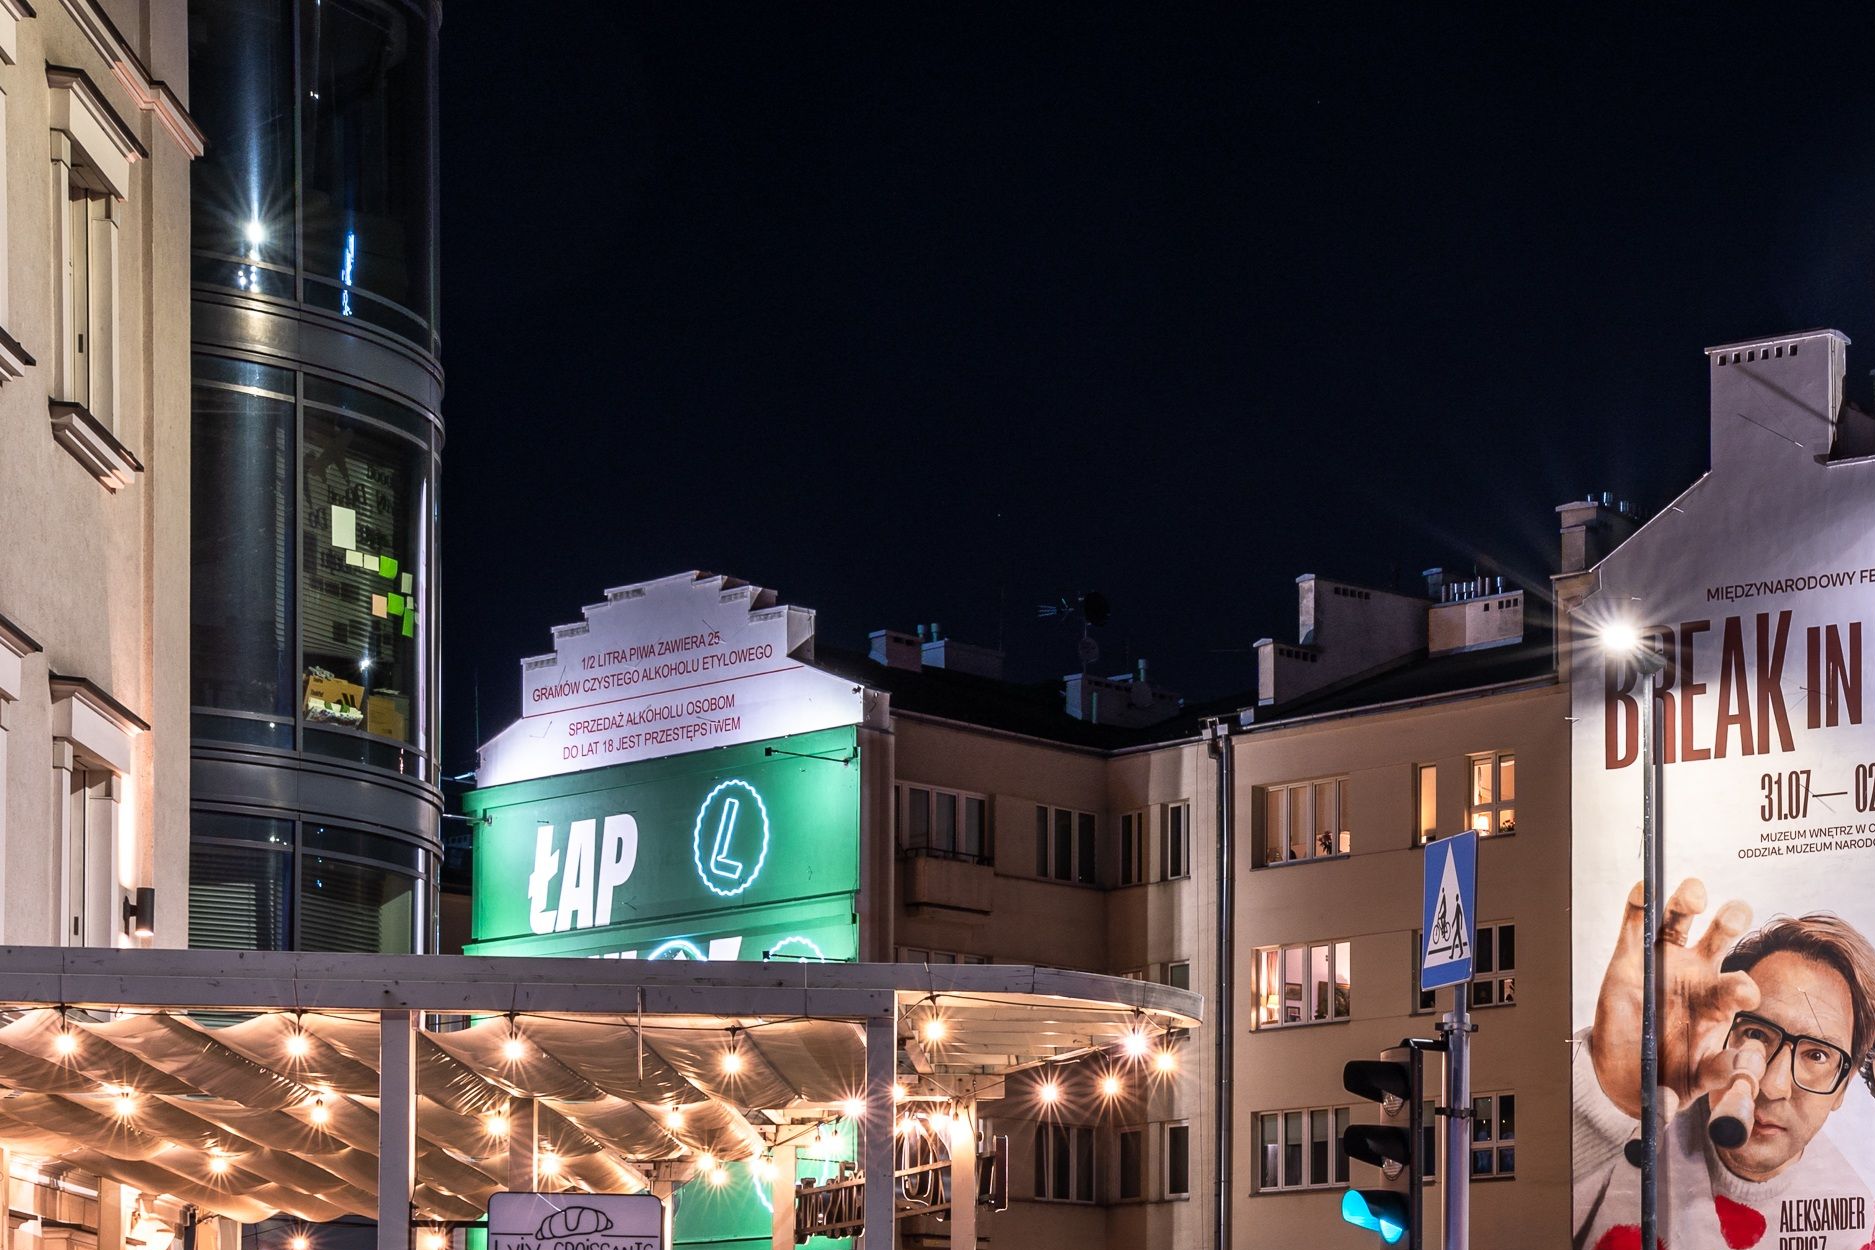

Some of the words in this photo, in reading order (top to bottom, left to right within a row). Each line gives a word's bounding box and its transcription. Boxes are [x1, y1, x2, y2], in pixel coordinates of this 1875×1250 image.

[1707, 571, 1856, 603] MIĘDZYNARODOWY
[581, 655, 596, 671] 1/2
[598, 650, 628, 668] LITRA
[629, 644, 656, 661] PIWA
[657, 634, 706, 656] ZAWIERA
[708, 631, 720, 646] 25
[532, 680, 580, 702] GRAMÓW
[582, 669, 640, 693] CZYSTEGO
[642, 659, 700, 682] ALKOHOLU
[702, 644, 773, 671] ETYLOWEGO
[1604, 609, 1796, 770] BREAK
[1806, 621, 1863, 730] IN
[568, 712, 624, 737] SPRZEDAŻ
[626, 703, 684, 727] ALKOHOLU
[686, 694, 735, 715] OSOBOM
[563, 745, 579, 760] DO
[581, 741, 599, 757] LAT
[602, 738, 614, 753] 18
[616, 734, 642, 751] JEST
[644, 716, 741, 746] PRZESTĘPSTWEM
[1760, 769, 1811, 822] 31.07
[1738, 847, 1784, 859] ODDZIAŁ
[1785, 842, 1833, 855] MUZEUM
[1760, 829, 1807, 843] MUZEUM
[1809, 825, 1853, 839] WNĘTRZ
[1855, 823, 1867, 834] W
[527, 813, 639, 935] ŁAP
[1779, 1196, 1865, 1233] ALEKSANDER
